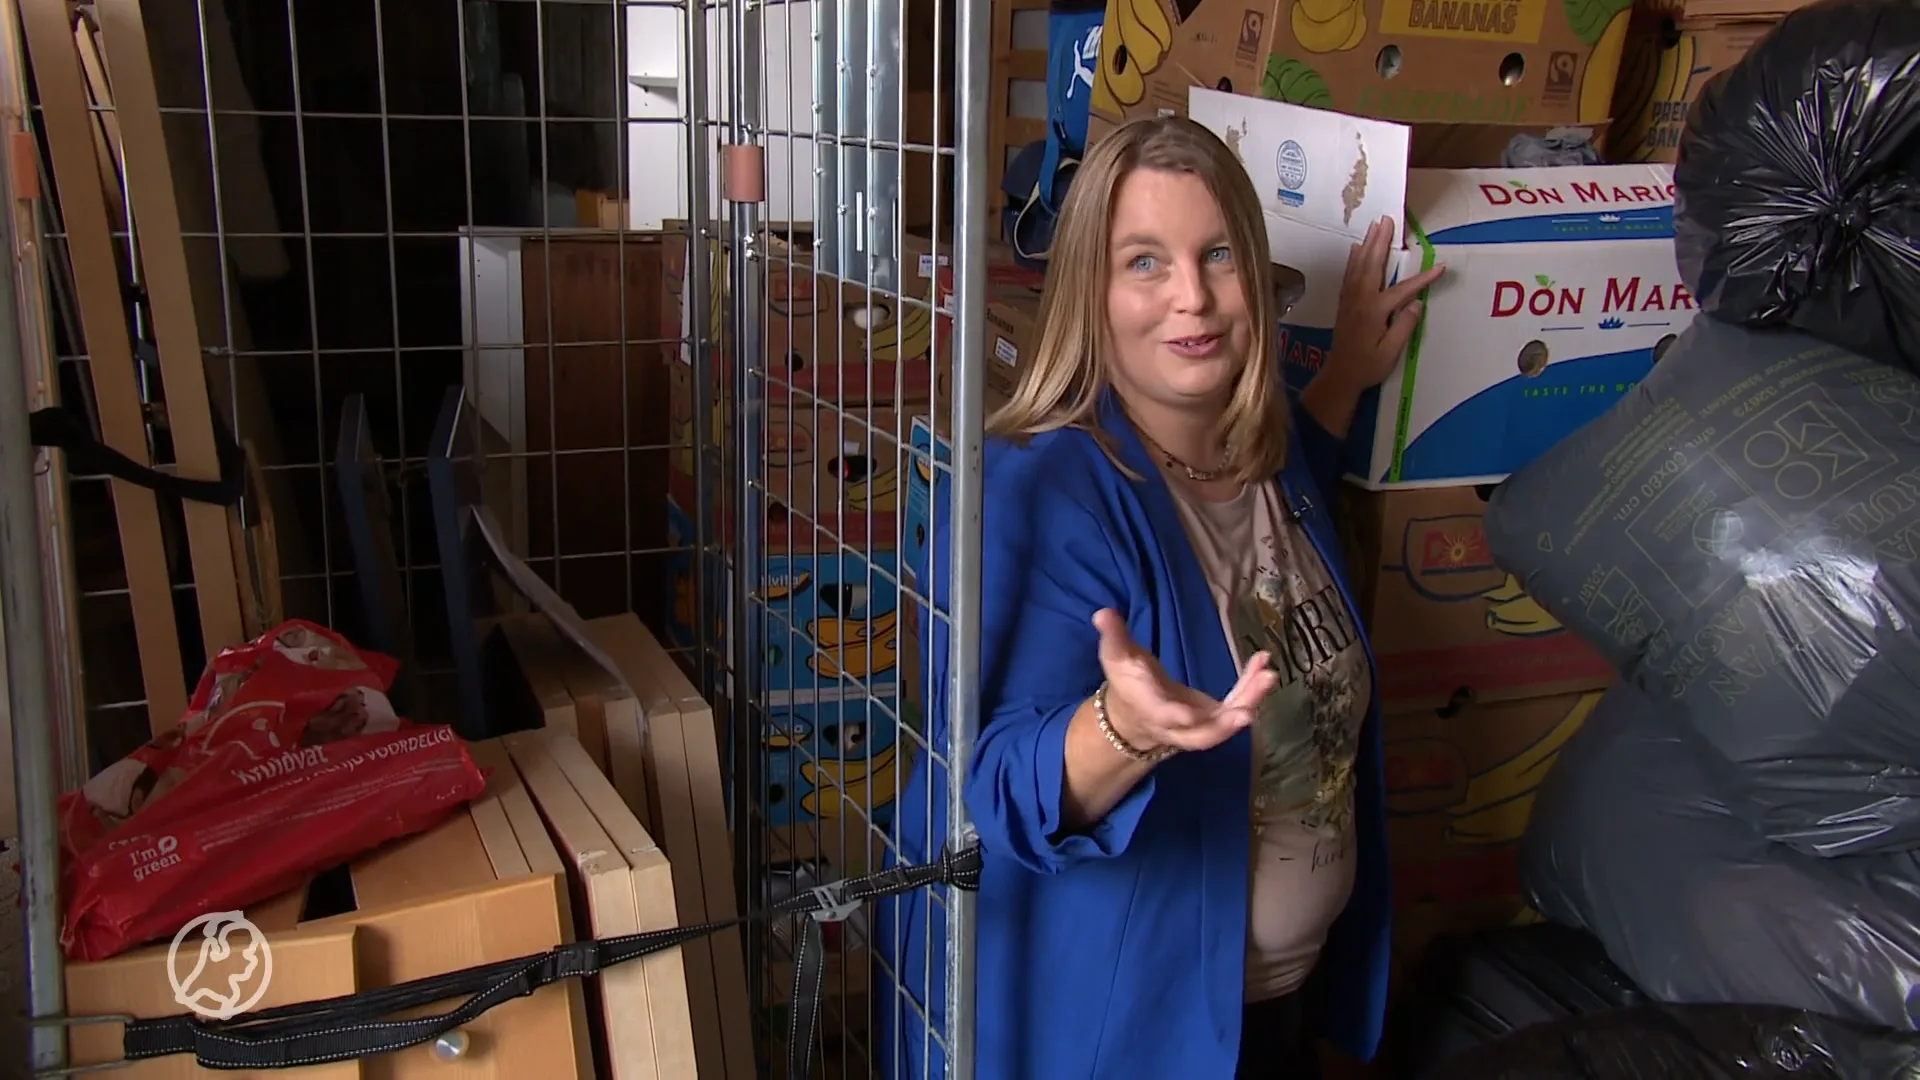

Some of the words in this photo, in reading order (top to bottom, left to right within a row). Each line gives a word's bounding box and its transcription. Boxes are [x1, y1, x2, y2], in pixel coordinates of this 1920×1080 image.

[1408, 0, 1518, 34] BANANAS
[1357, 87, 1532, 121] FAIRTRADE
[1479, 183, 1565, 205] DON
[1490, 280, 1585, 317] DON
[1602, 276, 1702, 313] MAR
[1523, 385, 1570, 398] TASTE
[1580, 384, 1606, 395] THE
[1615, 382, 1641, 394] WO
[130, 847, 158, 866] I'm
[133, 853, 182, 882] green
